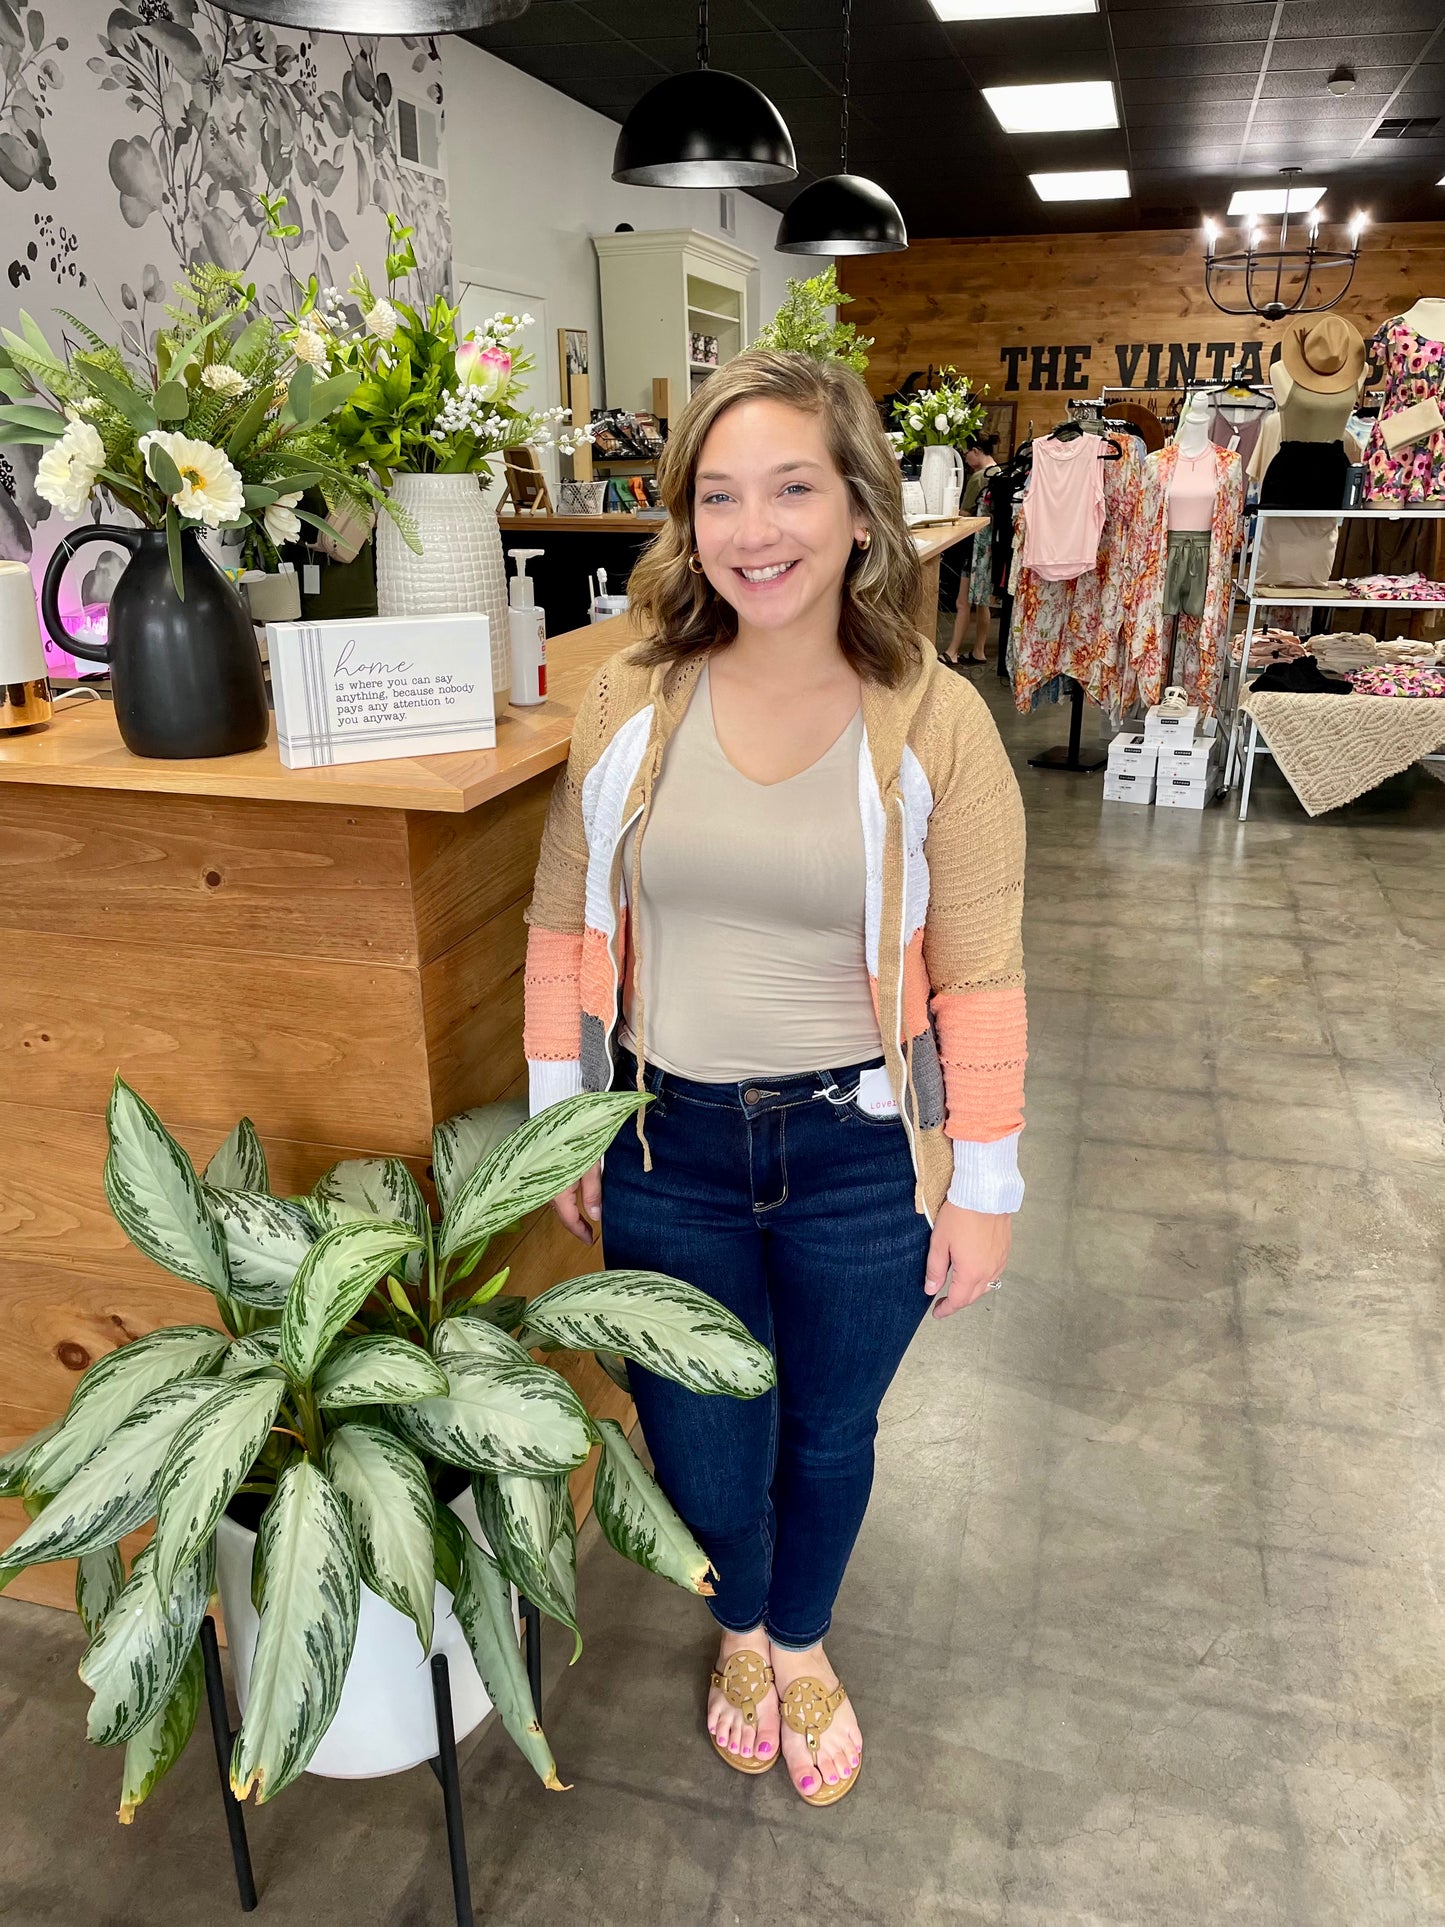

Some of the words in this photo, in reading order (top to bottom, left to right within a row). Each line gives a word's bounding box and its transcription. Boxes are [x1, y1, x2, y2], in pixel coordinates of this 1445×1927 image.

[1000, 345, 1092, 391] THE
[1115, 341, 1283, 388] VINTA
[333, 639, 415, 678] home
[335, 682, 344, 691] is
[349, 680, 383, 690] where
[387, 678, 408, 689] you
[411, 676, 431, 685] can
[434, 675, 453, 685] say
[335, 690, 389, 704] anything,
[392, 688, 434, 698] because
[438, 683, 475, 694] nobody
[336, 704, 364, 716] pays
[368, 703, 388, 712] any
[393, 698, 441, 709] attention
[445, 696, 456, 704] to
[338, 716, 359, 728] you
[363, 712, 408, 724] anyway.
